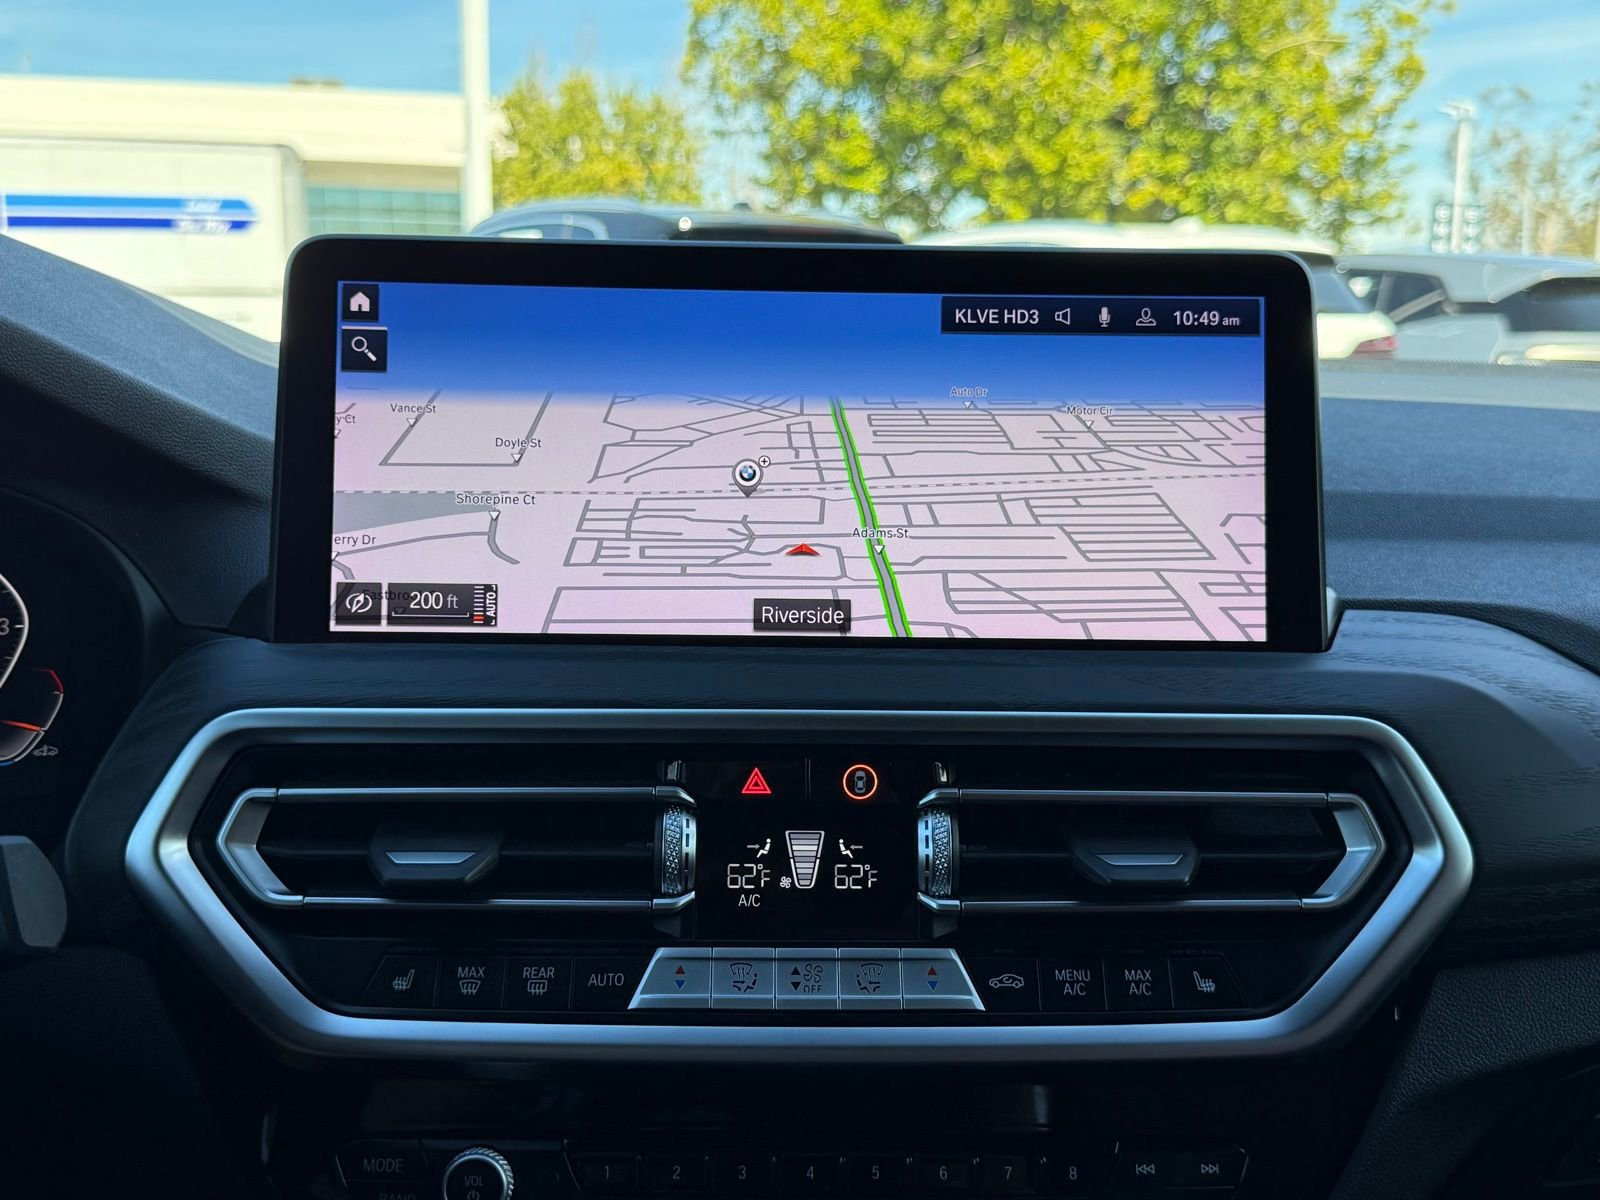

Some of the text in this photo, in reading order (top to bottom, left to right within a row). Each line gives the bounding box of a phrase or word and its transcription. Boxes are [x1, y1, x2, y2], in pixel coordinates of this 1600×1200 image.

[955, 308, 1039, 325] KLVE HD3
[1173, 310, 1240, 327] 10:49 am
[950, 386, 988, 397] Auto Dr
[391, 403, 437, 414] Vance St
[1067, 405, 1097, 416] Motor
[345, 414, 356, 424] Ct
[495, 437, 542, 449] Doyle St
[456, 493, 536, 506] Shorepine Ct
[362, 534, 376, 545] Dr
[852, 528, 909, 539] Adams St
[409, 591, 459, 610] 200 ft
[485, 592, 497, 617] AUTO
[761, 606, 845, 625] Riverside
[738, 894, 761, 908] A/C
[457, 966, 485, 979] MAX
[522, 966, 555, 979] REAR
[1055, 969, 1090, 982] MENU
[1125, 969, 1152, 982] MAX
[588, 973, 624, 987] AUTO
[803, 984, 823, 994] OFF
[1063, 982, 1087, 996] A/C
[1129, 982, 1152, 996] A/C
[363, 1157, 404, 1173] MODE
[603, 1164, 610, 1180] 1
[672, 1164, 681, 1180] 2
[738, 1164, 747, 1180] 3
[806, 1164, 815, 1180] 4
[871, 1164, 880, 1180] 5
[939, 1164, 948, 1180] 6
[1004, 1164, 1012, 1180] 7
[1068, 1164, 1077, 1180] 8
[464, 1175, 484, 1187] VOL
